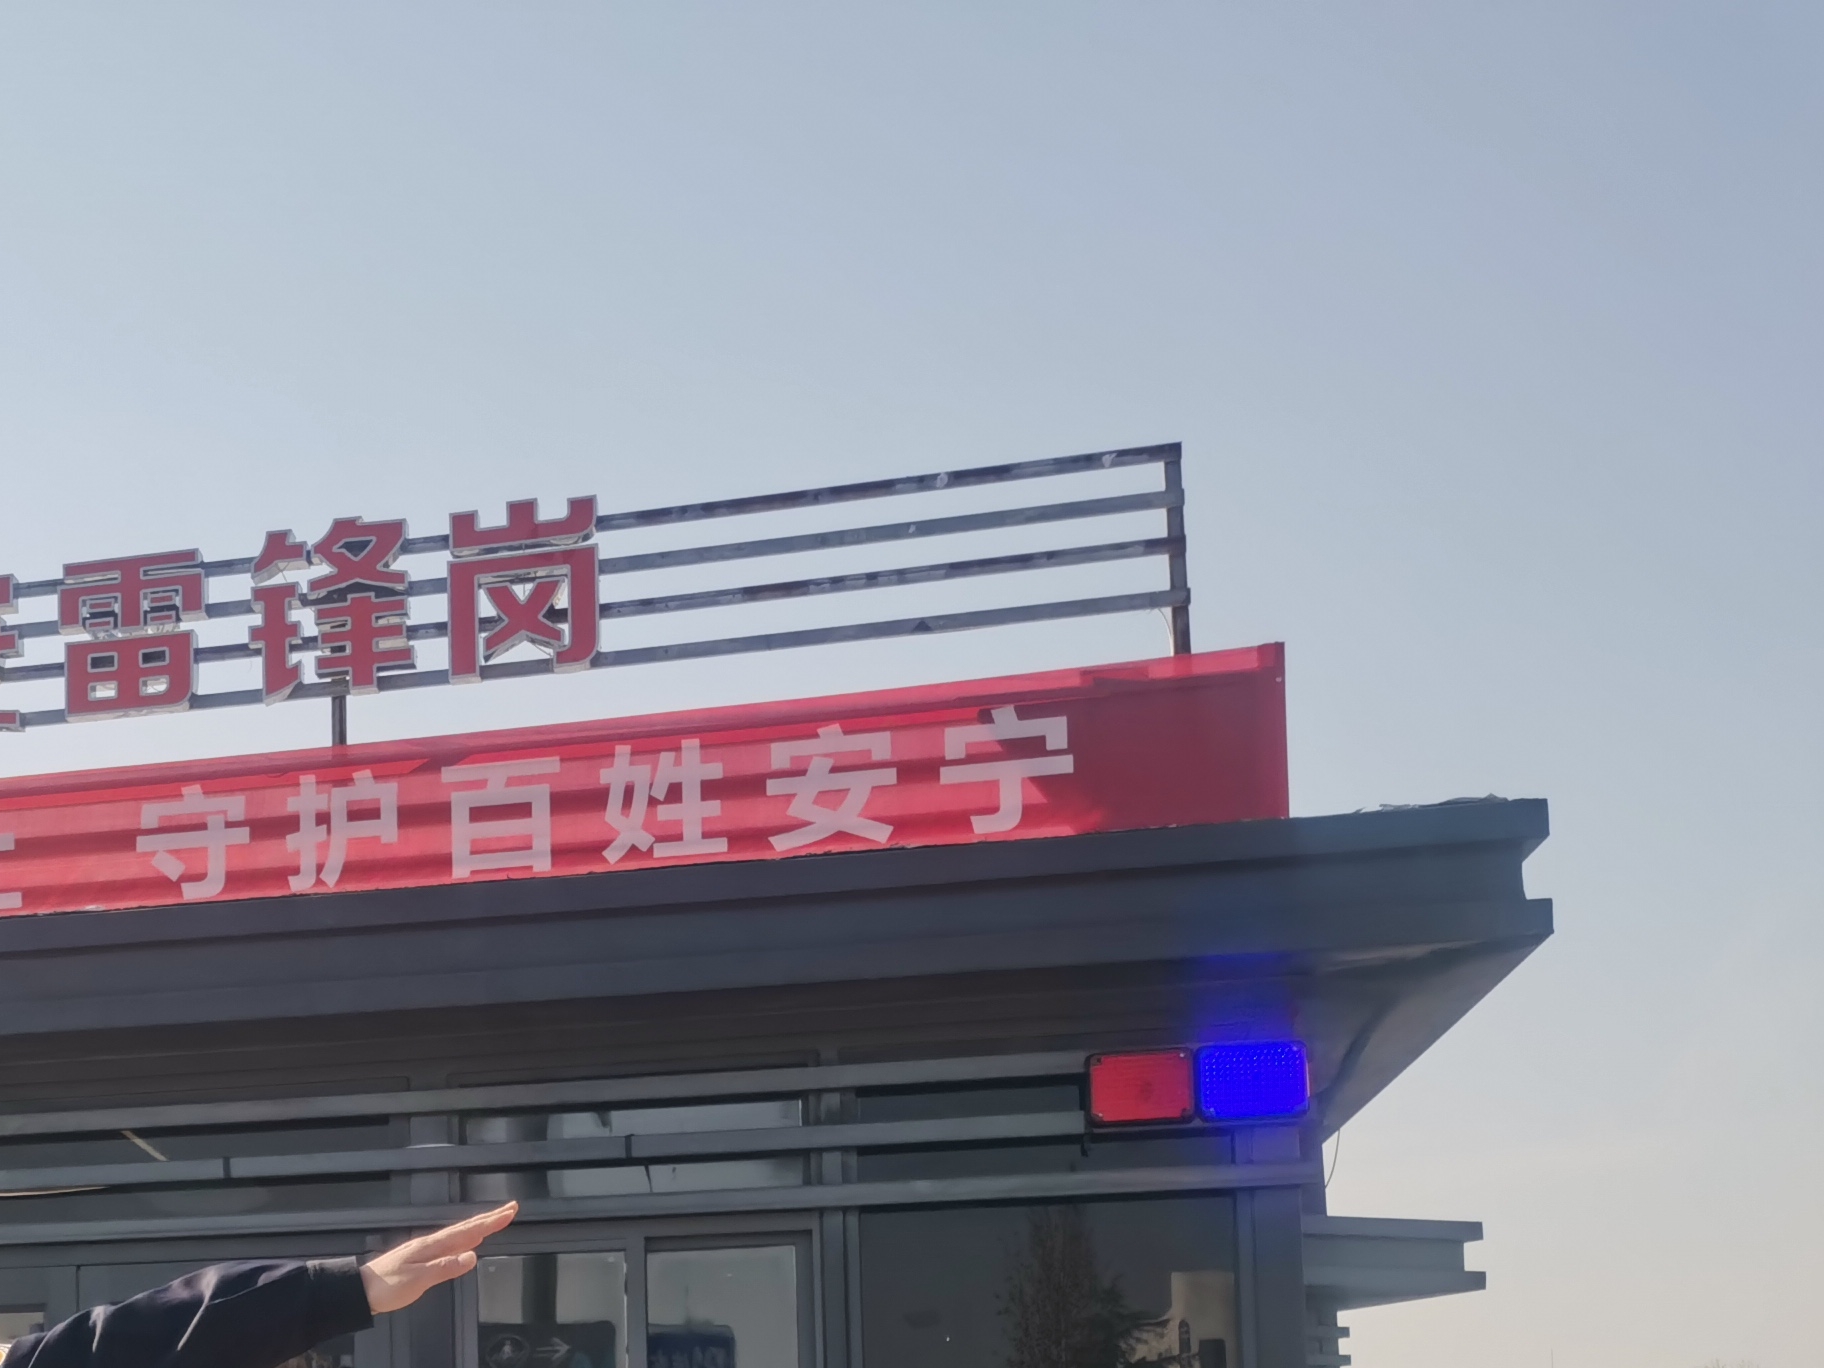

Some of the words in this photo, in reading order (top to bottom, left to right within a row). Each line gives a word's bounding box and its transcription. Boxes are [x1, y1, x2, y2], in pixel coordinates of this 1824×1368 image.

[135, 708, 1079, 900] 守护百姓安宁
